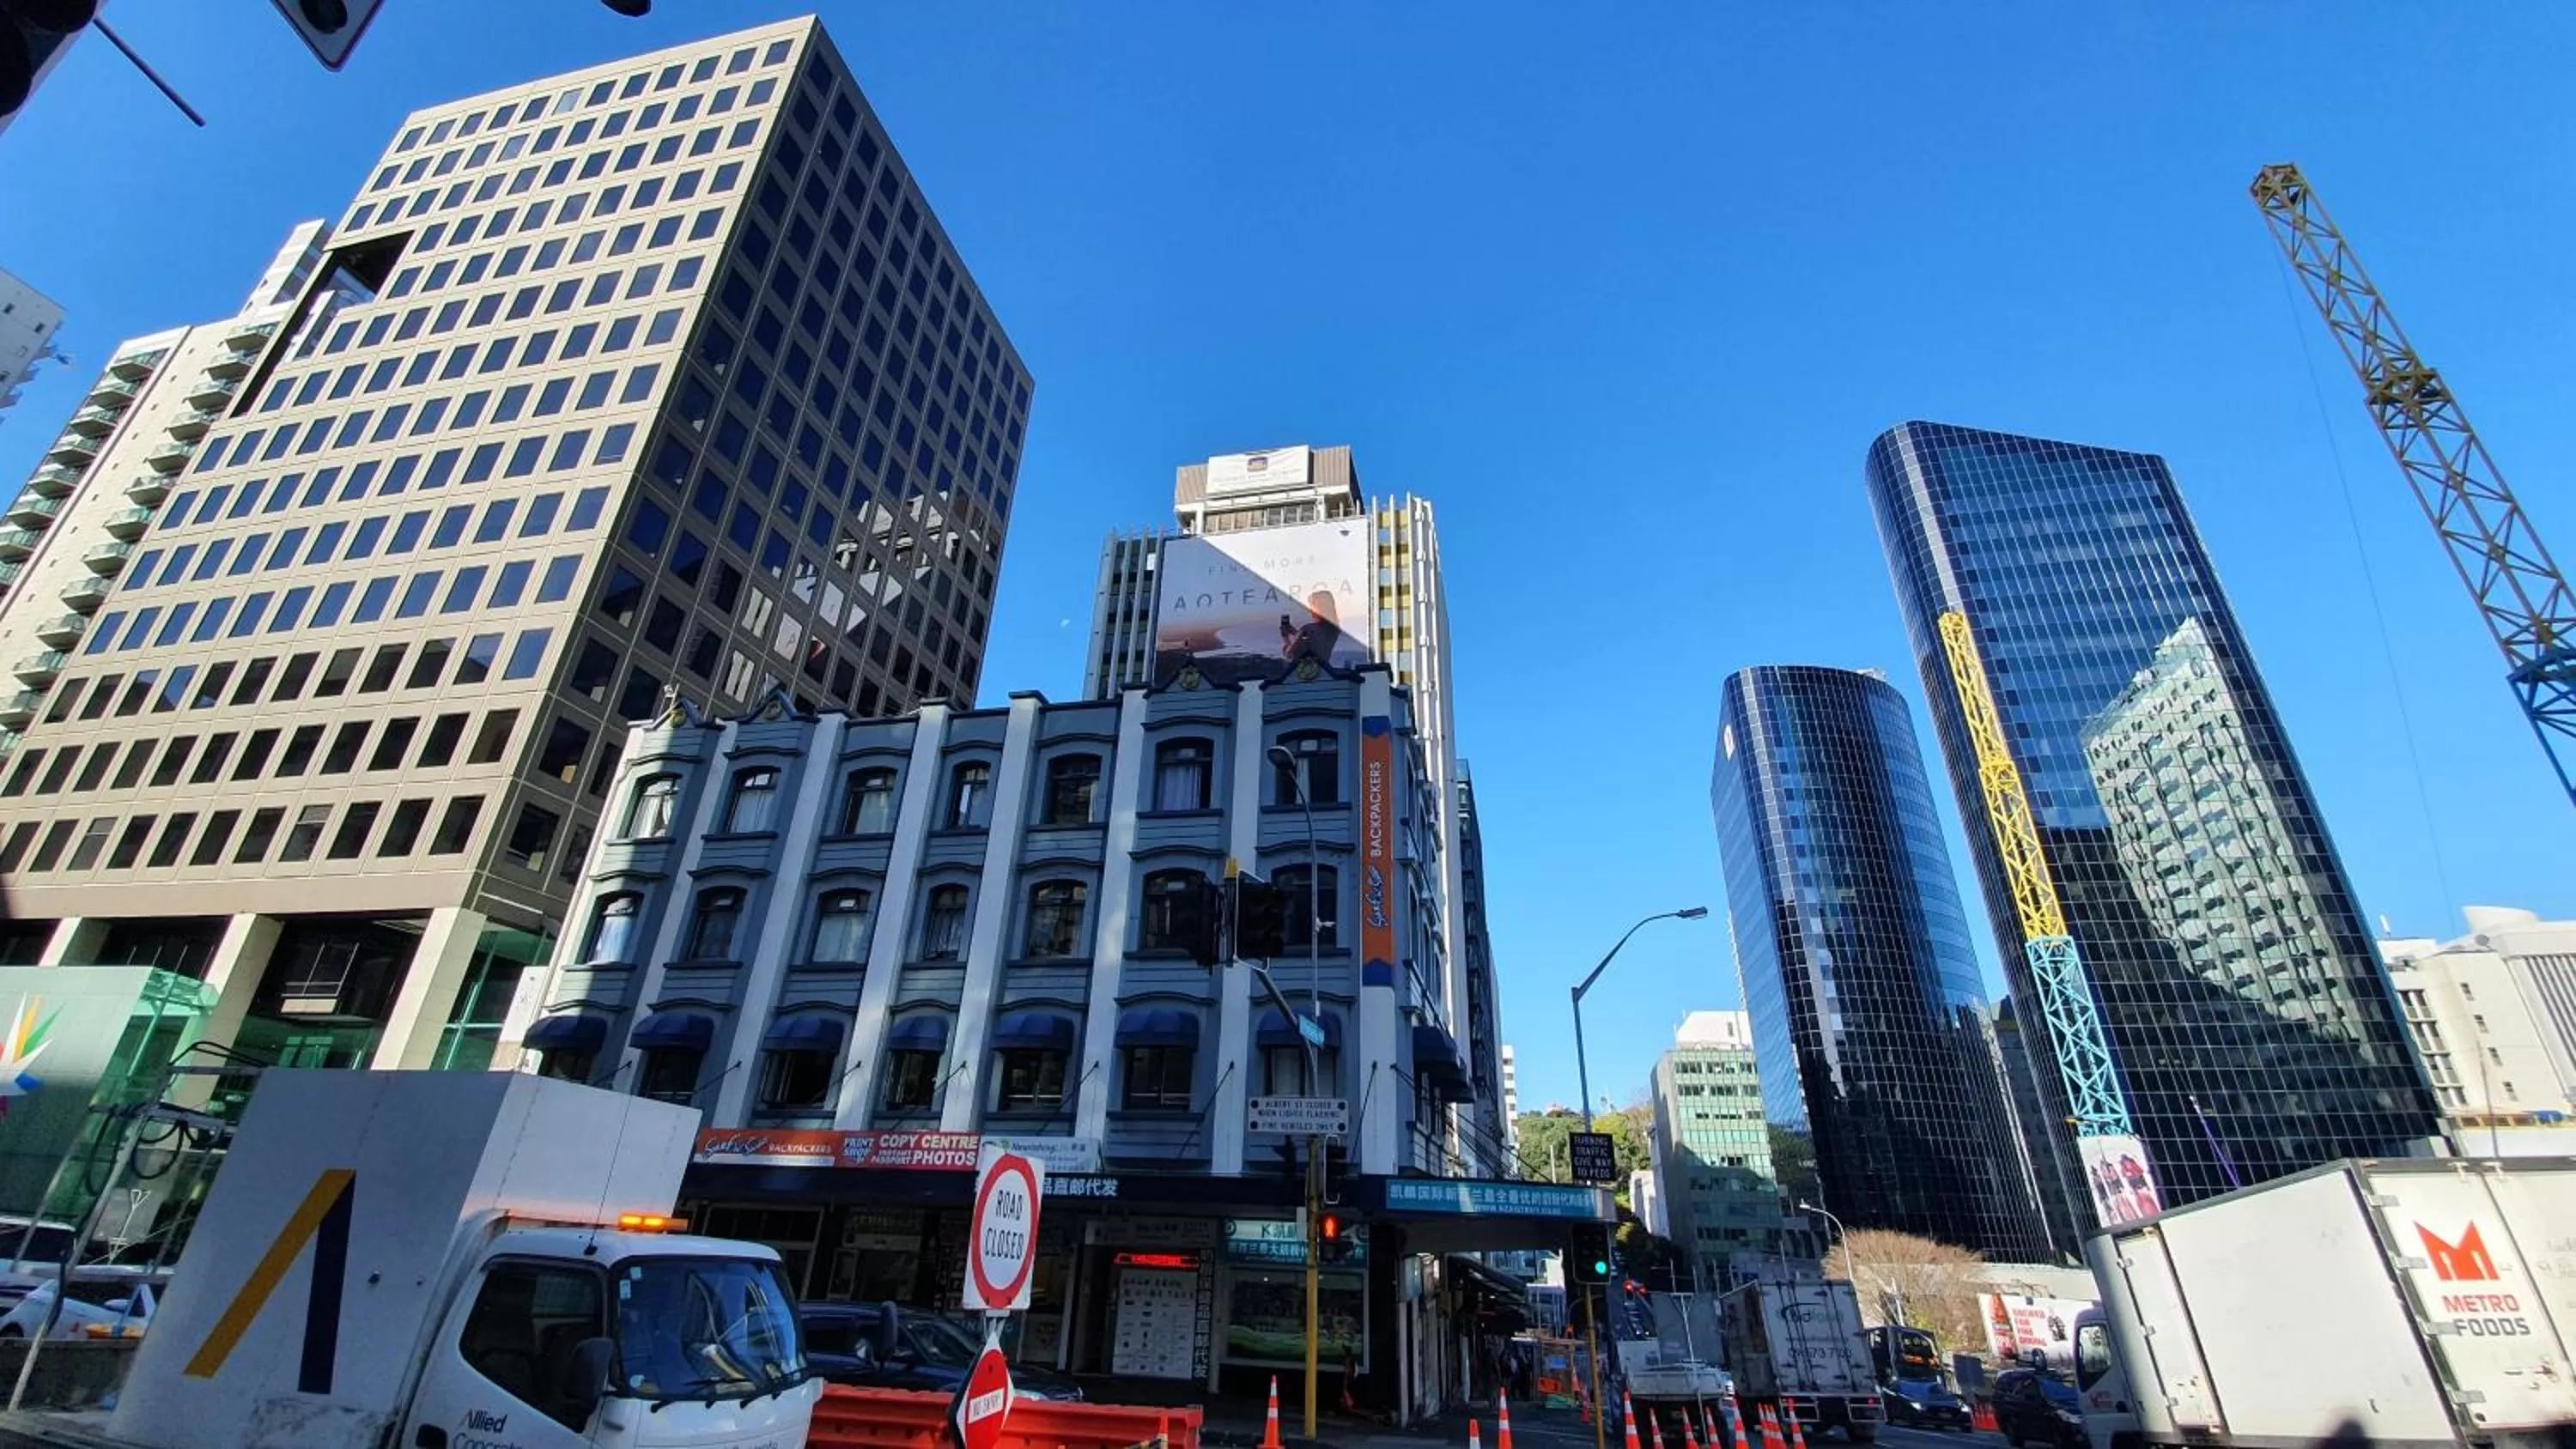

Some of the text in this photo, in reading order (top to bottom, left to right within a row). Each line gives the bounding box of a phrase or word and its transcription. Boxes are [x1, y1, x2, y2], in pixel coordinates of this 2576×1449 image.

[1369, 761, 1382, 857] BACKPACKERS
[769, 1143, 832, 1154] BACKPACKERS
[879, 1135, 979, 1149] COPY CENTRE
[913, 1151, 976, 1166] PHOTOS
[995, 1189, 1024, 1221] ROAD
[985, 1228, 1024, 1260] CLOSED
[2441, 1294, 2520, 1313] METRO
[2452, 1318, 2531, 1337] FOODS
[458, 1408, 509, 1434] Allied
